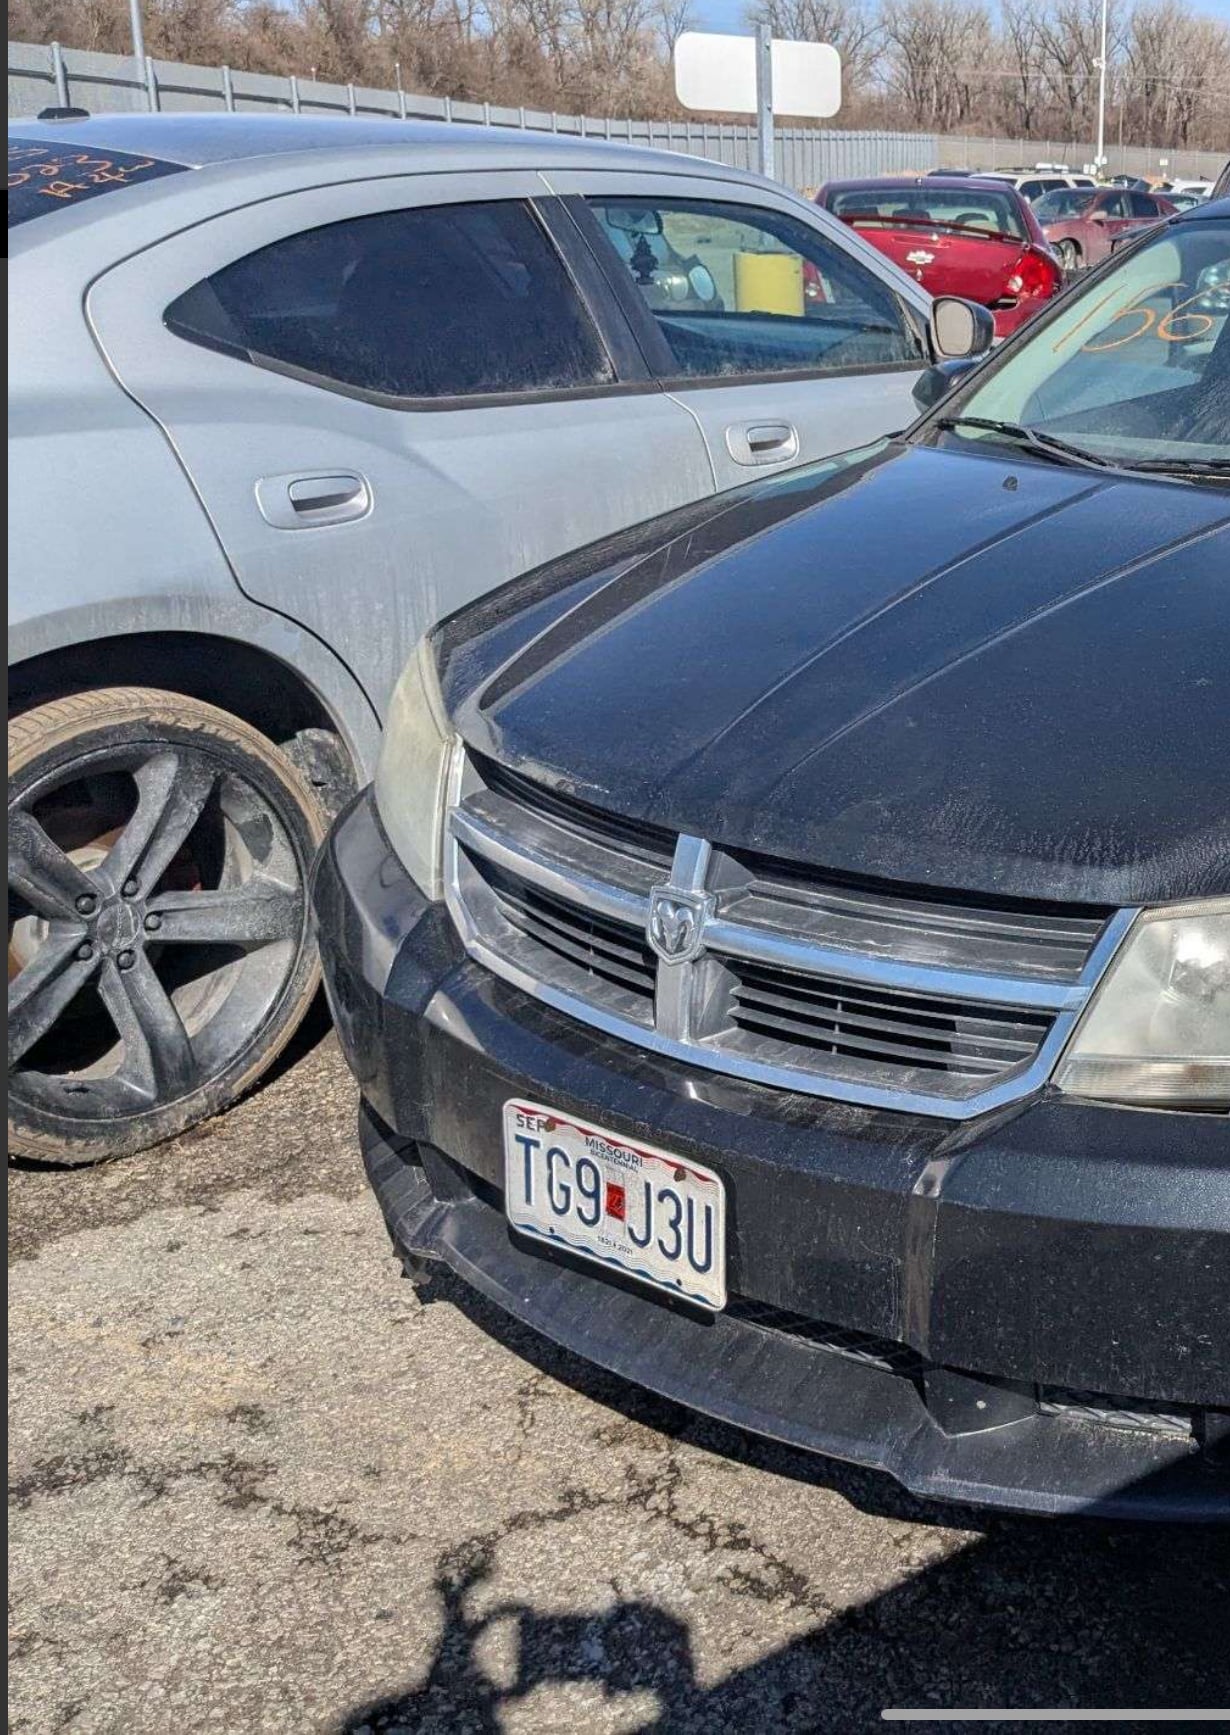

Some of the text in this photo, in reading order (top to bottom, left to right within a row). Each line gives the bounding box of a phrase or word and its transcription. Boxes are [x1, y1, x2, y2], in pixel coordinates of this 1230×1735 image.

[585, 1136, 643, 1167] MISSOURI
[515, 1133, 601, 1227] TG9
[627, 1181, 712, 1275] J3U
